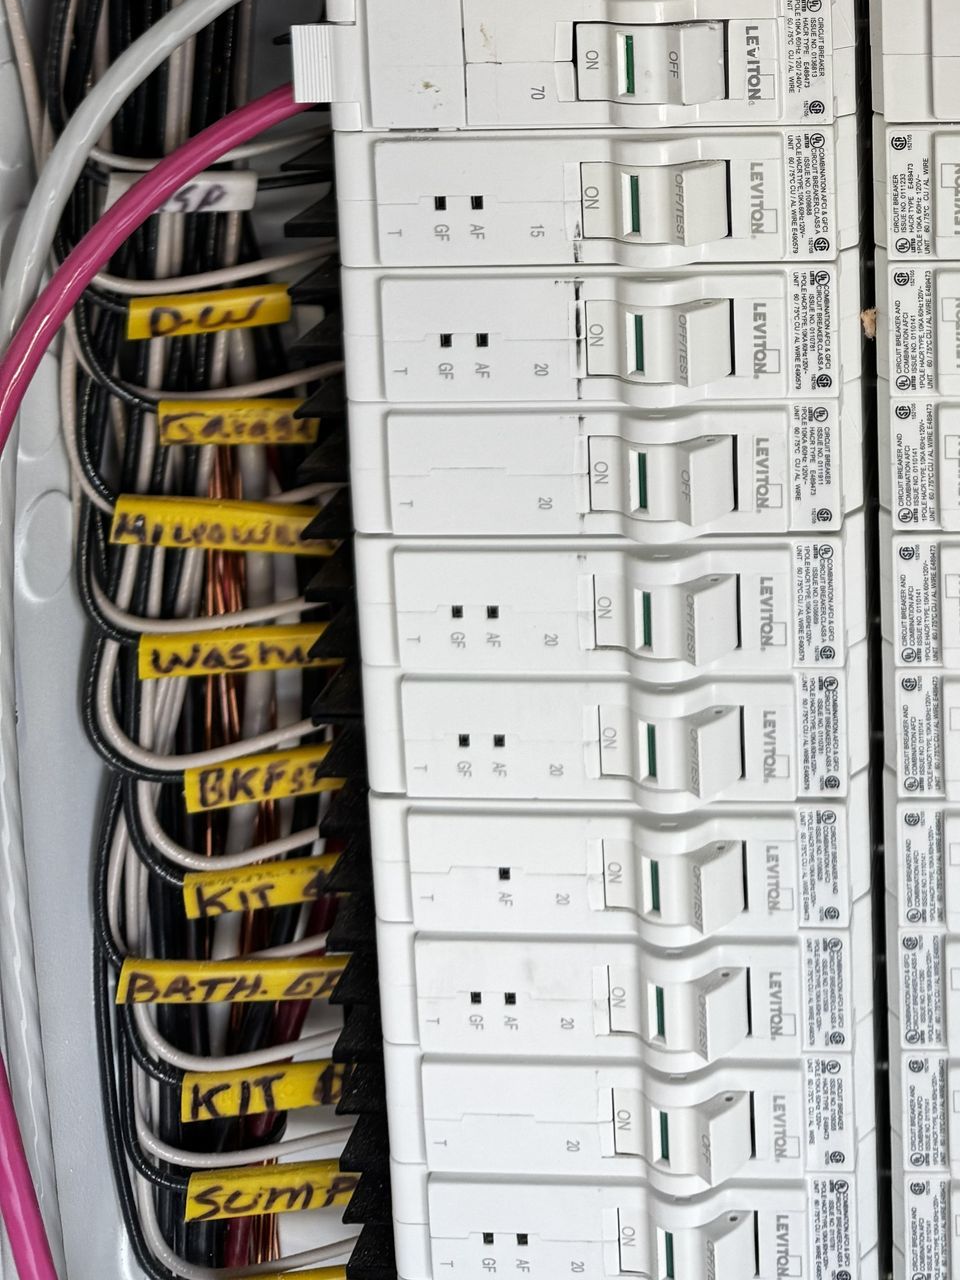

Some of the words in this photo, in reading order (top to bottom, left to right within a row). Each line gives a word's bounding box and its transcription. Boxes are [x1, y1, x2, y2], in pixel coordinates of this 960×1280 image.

[586, 51, 599, 69] ON
[669, 51, 678, 79] OFF
[744, 25, 758, 100] LEVITON
[531, 86, 545, 100] 70
[750, 162, 763, 233] LEVITON
[434, 224, 450, 241] GF
[470, 224, 485, 239] AF
[530, 225, 544, 237] 15
[753, 302, 767, 373] LEVITON
[534, 364, 549, 376] 20
[755, 438, 769, 508] LEVITON
[538, 497, 552, 510] 20
[760, 577, 772, 646] LEVITON
[544, 634, 558, 646] 20
[763, 710, 776, 778] LEVITON
[549, 764, 563, 776] 20
[766, 845, 779, 910] LEVITON
[195, 884, 276, 916] KIT
[556, 893, 570, 905] 20
[769, 971, 781, 1036] LEVITON
[561, 1018, 574, 1029] 20
[190, 1072, 285, 1120] KIT
[772, 1095, 786, 1159] LEVITON
[567, 1140, 580, 1152] 20
[775, 1215, 788, 1276] LEVITON
[571, 1261, 584, 1273] 20
